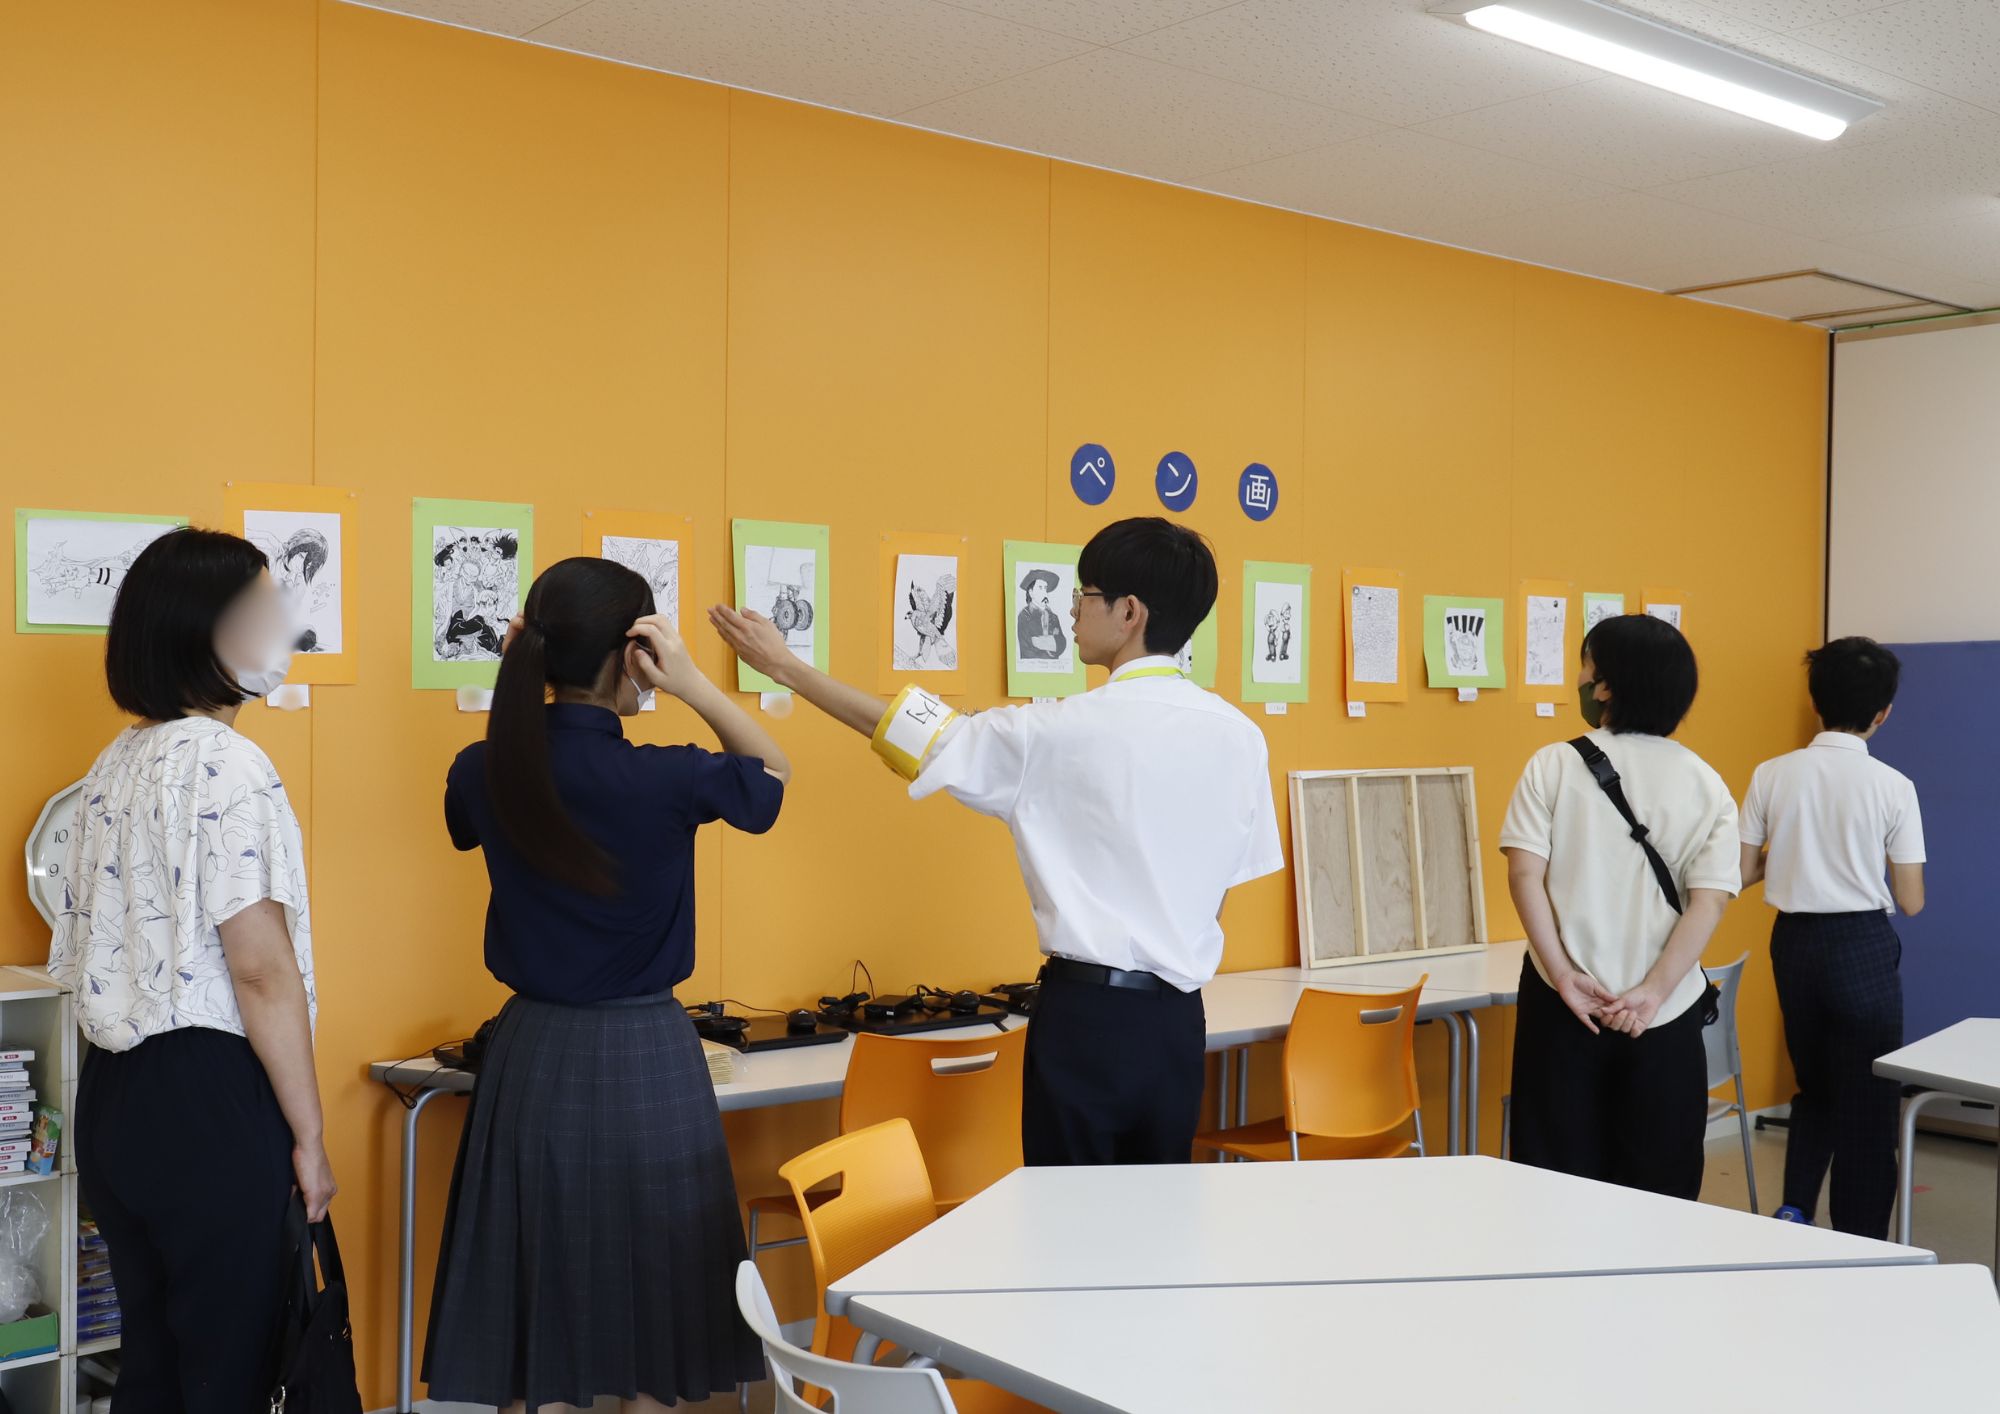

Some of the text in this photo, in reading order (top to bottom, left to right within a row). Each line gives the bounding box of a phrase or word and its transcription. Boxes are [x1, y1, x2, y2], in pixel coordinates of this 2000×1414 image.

[1079, 456, 1271, 511] ペン画
[905, 692, 939, 725] 内
[54, 829, 69, 844] 10
[49, 863, 59, 877] 9
